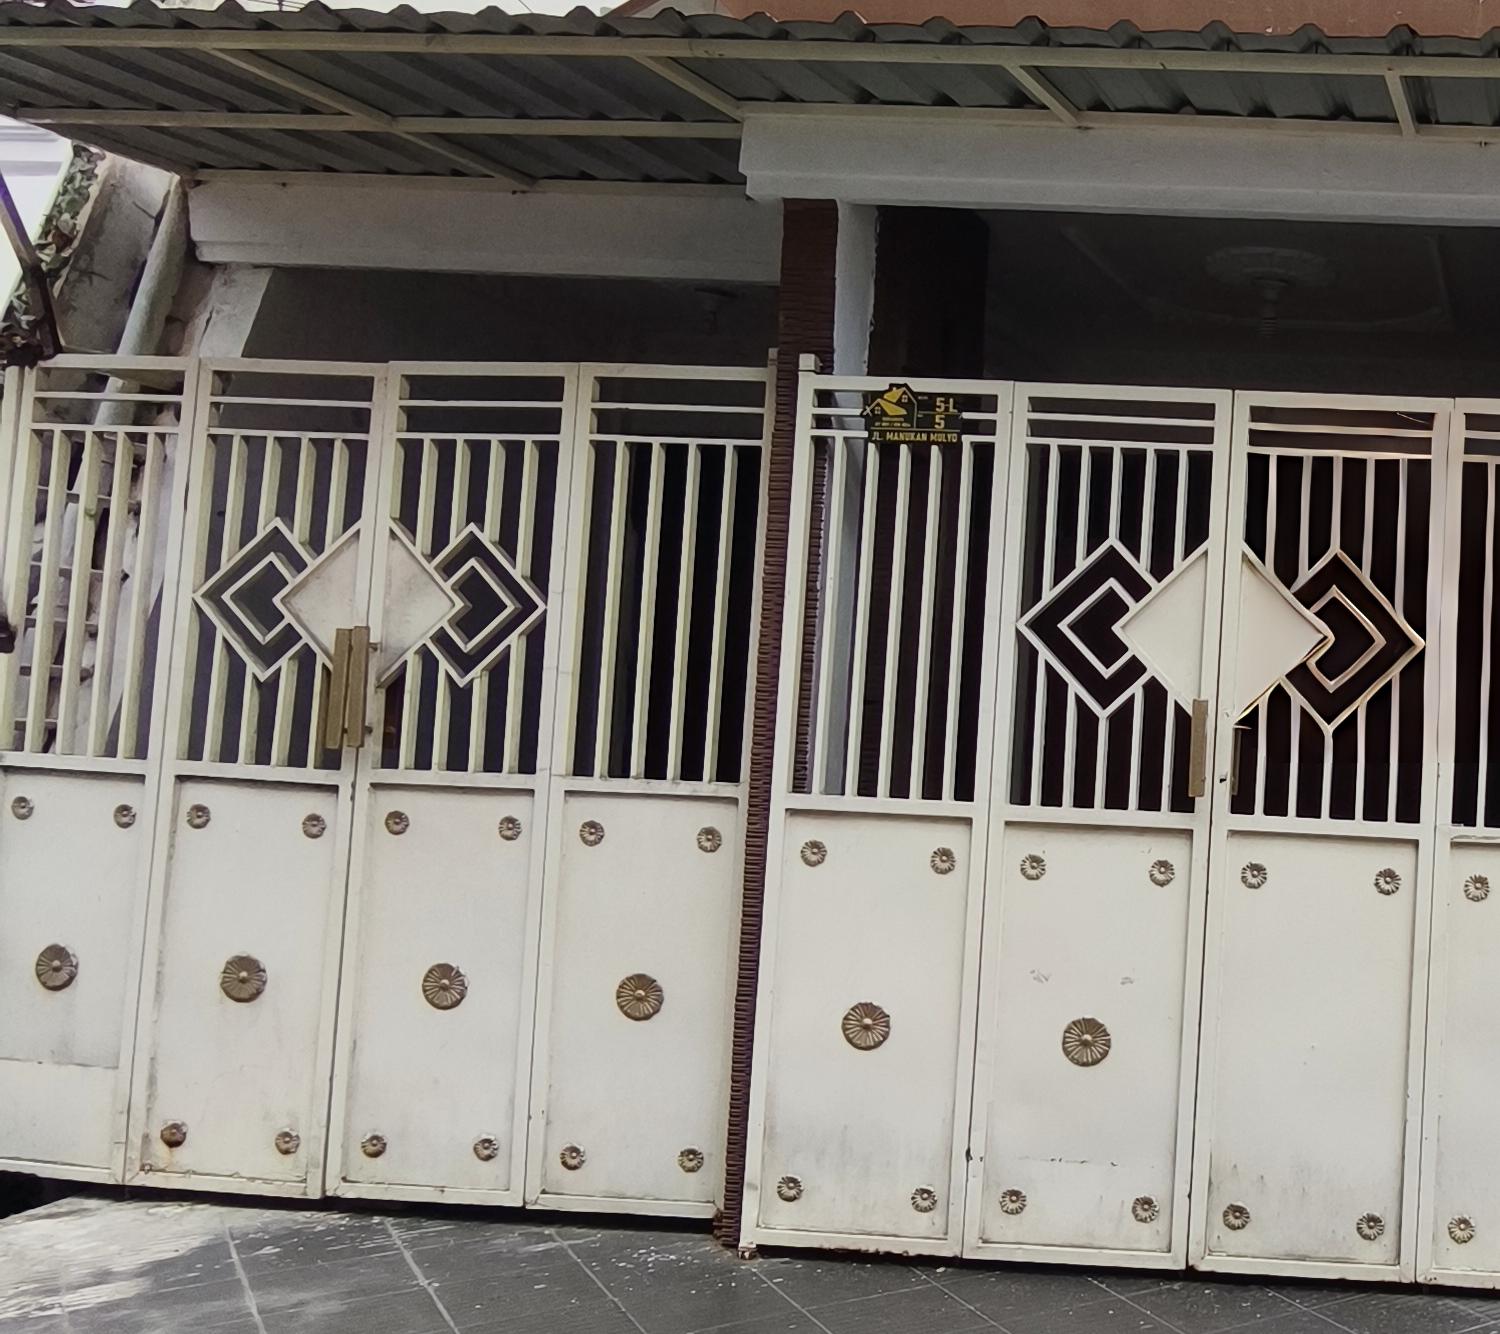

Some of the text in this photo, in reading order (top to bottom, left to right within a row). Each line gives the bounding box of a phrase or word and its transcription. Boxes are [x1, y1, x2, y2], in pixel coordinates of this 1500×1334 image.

[934, 414, 946, 430] 5
[871, 431, 958, 443] JL. MANUKAN MULYO
